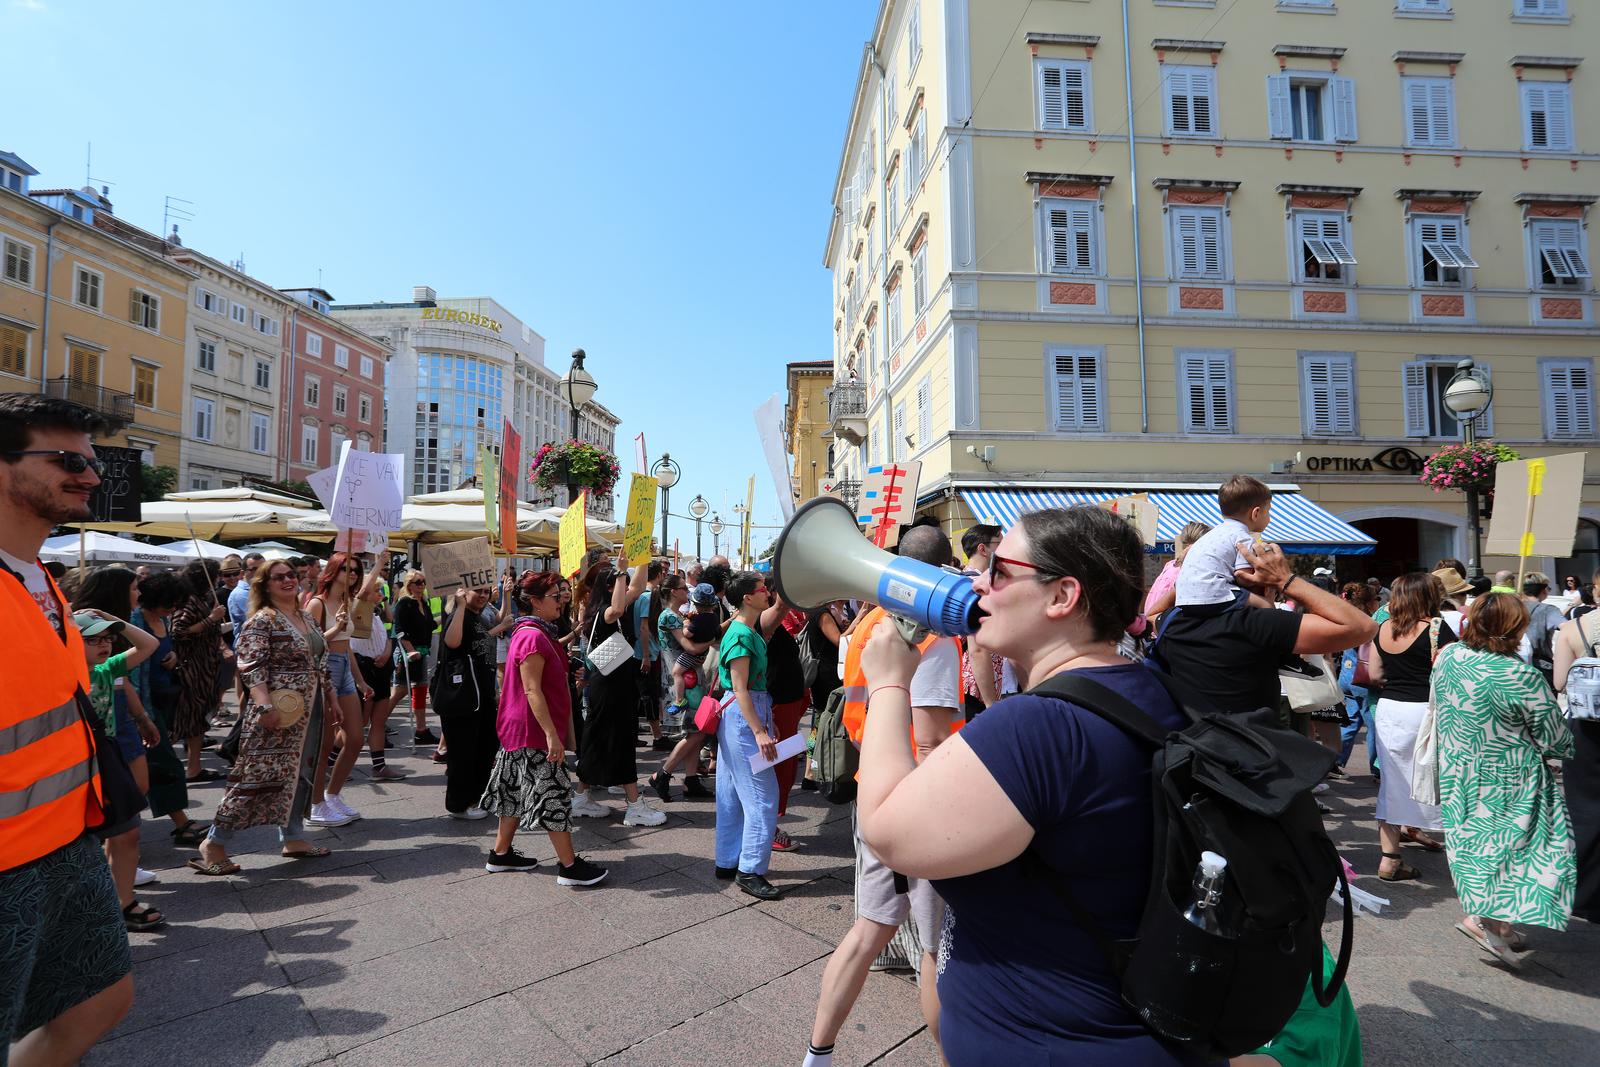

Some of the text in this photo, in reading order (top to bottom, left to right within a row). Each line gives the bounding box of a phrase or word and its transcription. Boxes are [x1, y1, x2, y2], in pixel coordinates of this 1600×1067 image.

[421, 307, 502, 334] EUROHERC
[1306, 457, 1373, 471] OPTIKA
[134, 553, 171, 562] McDonald's
